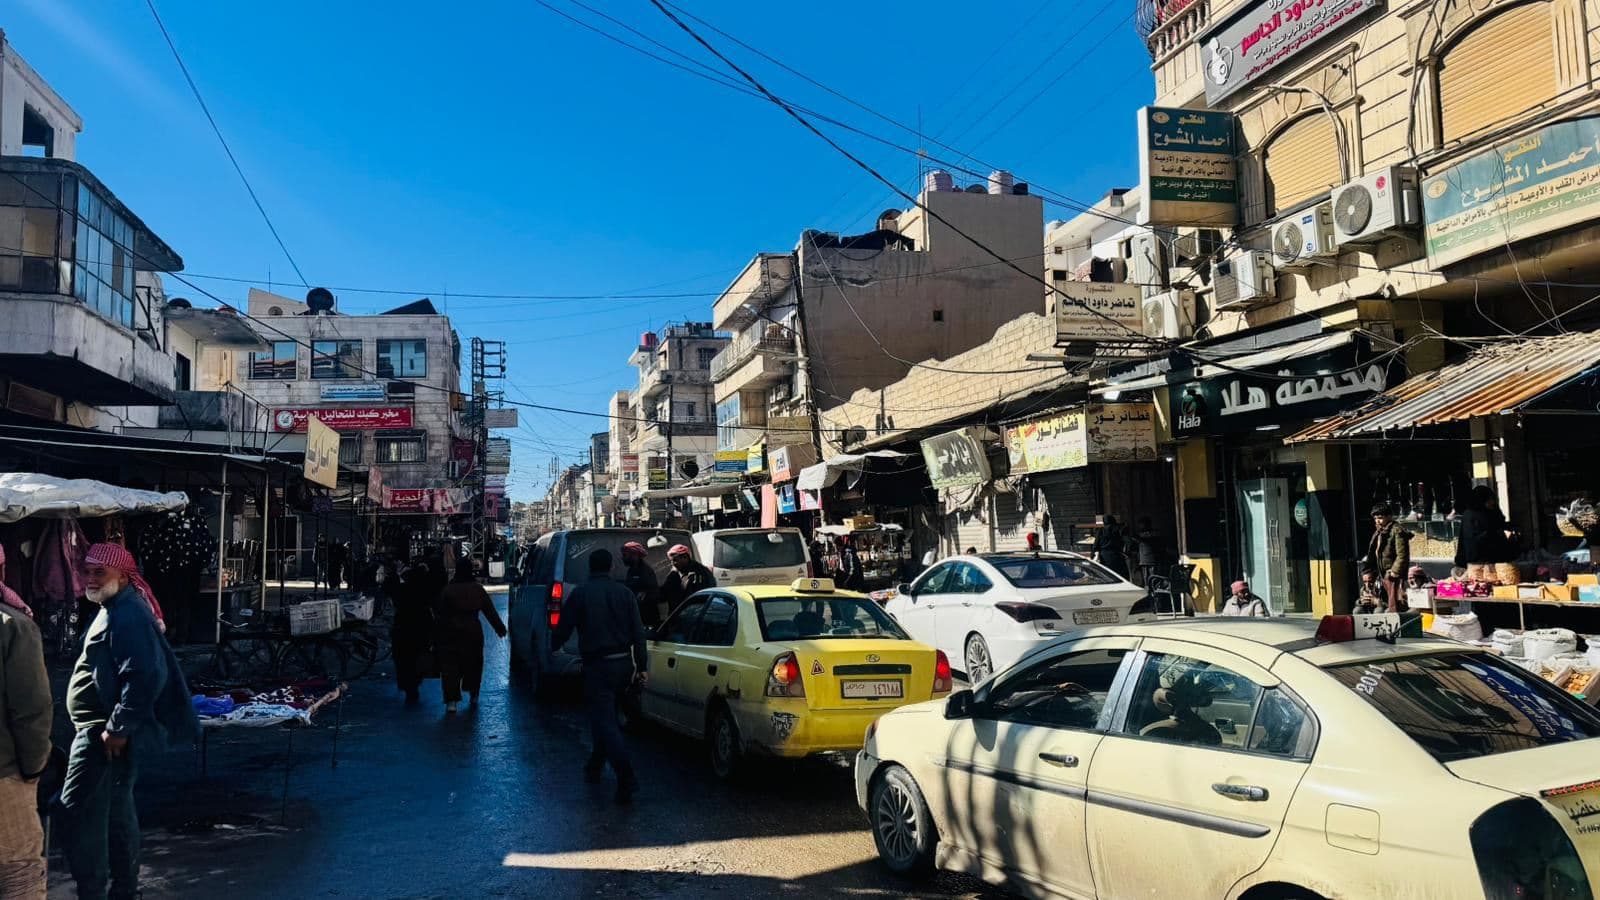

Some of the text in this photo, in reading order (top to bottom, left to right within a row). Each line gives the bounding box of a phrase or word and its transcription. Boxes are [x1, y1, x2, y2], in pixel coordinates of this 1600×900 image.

[1241, 12, 1282, 57] الجاسم
[1154, 128, 1230, 147] أحمد المشوح
[1461, 133, 1600, 208] أحمد المشوح
[1577, 168, 1600, 186] مراض
[1520, 183, 1548, 202] الأوعية
[1555, 176, 1576, 191] القلب
[1092, 298, 1109, 309] داود
[1111, 297, 1135, 310] تماضر
[1220, 365, 1385, 416] محمصة هلا
[321, 409, 355, 420] للتحاليل
[1094, 411, 1115, 424] نور
[1178, 415, 1201, 430] Hala
[1356, 663, 1386, 696] 2011
